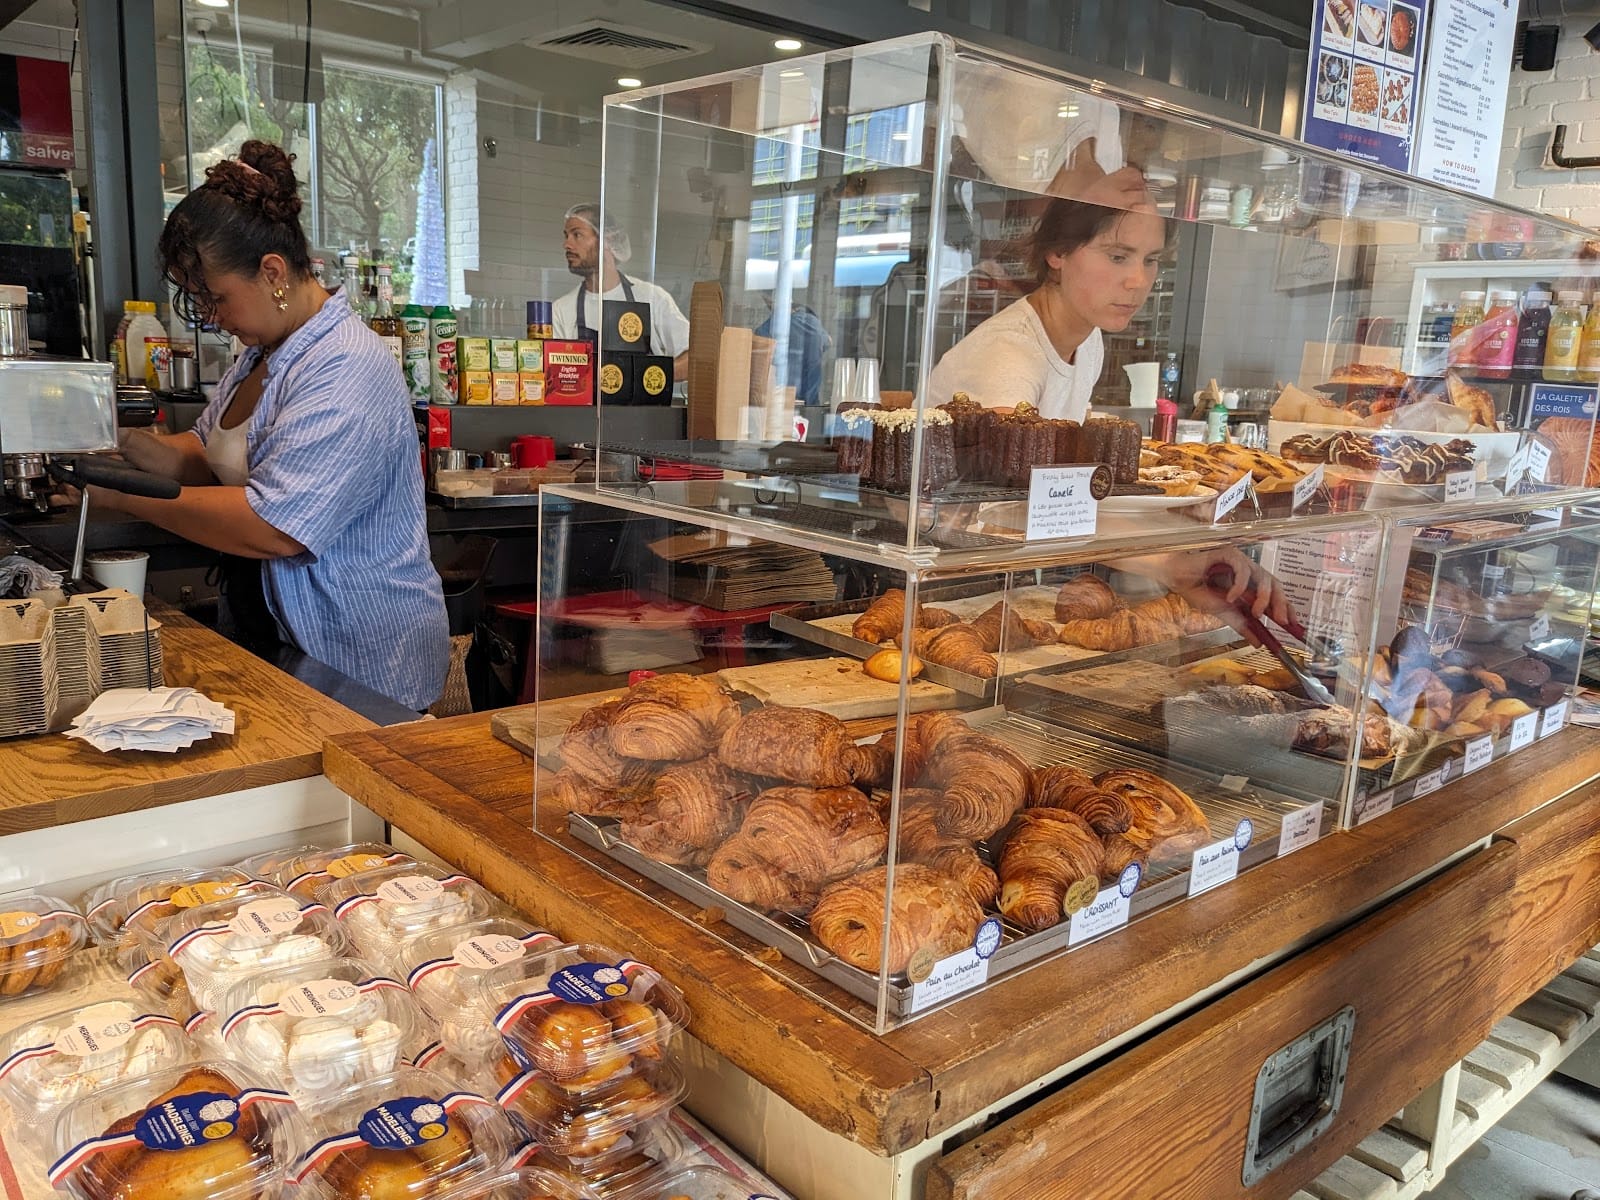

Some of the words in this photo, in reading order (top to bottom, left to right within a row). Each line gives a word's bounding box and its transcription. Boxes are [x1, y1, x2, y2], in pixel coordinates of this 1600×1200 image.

[26, 145, 74, 160] salva
[1460, 164, 1476, 174] ORDER
[550, 355, 587, 364] TWININGS
[560, 366, 577, 374] English
[558, 372, 580, 380] Breakfast
[1534, 404, 1551, 412] DES
[1552, 405, 1571, 414] ROIS
[1536, 393, 1547, 401] LA
[1548, 393, 1584, 404] GALETTE
[1048, 485, 1075, 498] Canelé
[392, 881, 419, 901] MERINGUES
[1083, 896, 1119, 920] CROISSANT
[250, 912, 272, 934] MERINGUES
[469, 941, 499, 966] MERINGUES
[925, 976, 942, 989] Pain
[943, 972, 953, 981] au
[953, 958, 981, 976] Chocolat
[560, 970, 604, 1001] MADELEINES
[300, 986, 326, 1014] MERINGUES
[78, 1025, 100, 1053] MERINGUES
[162, 1101, 196, 1146] MADELEINES
[376, 1106, 415, 1146] MADELEINES
